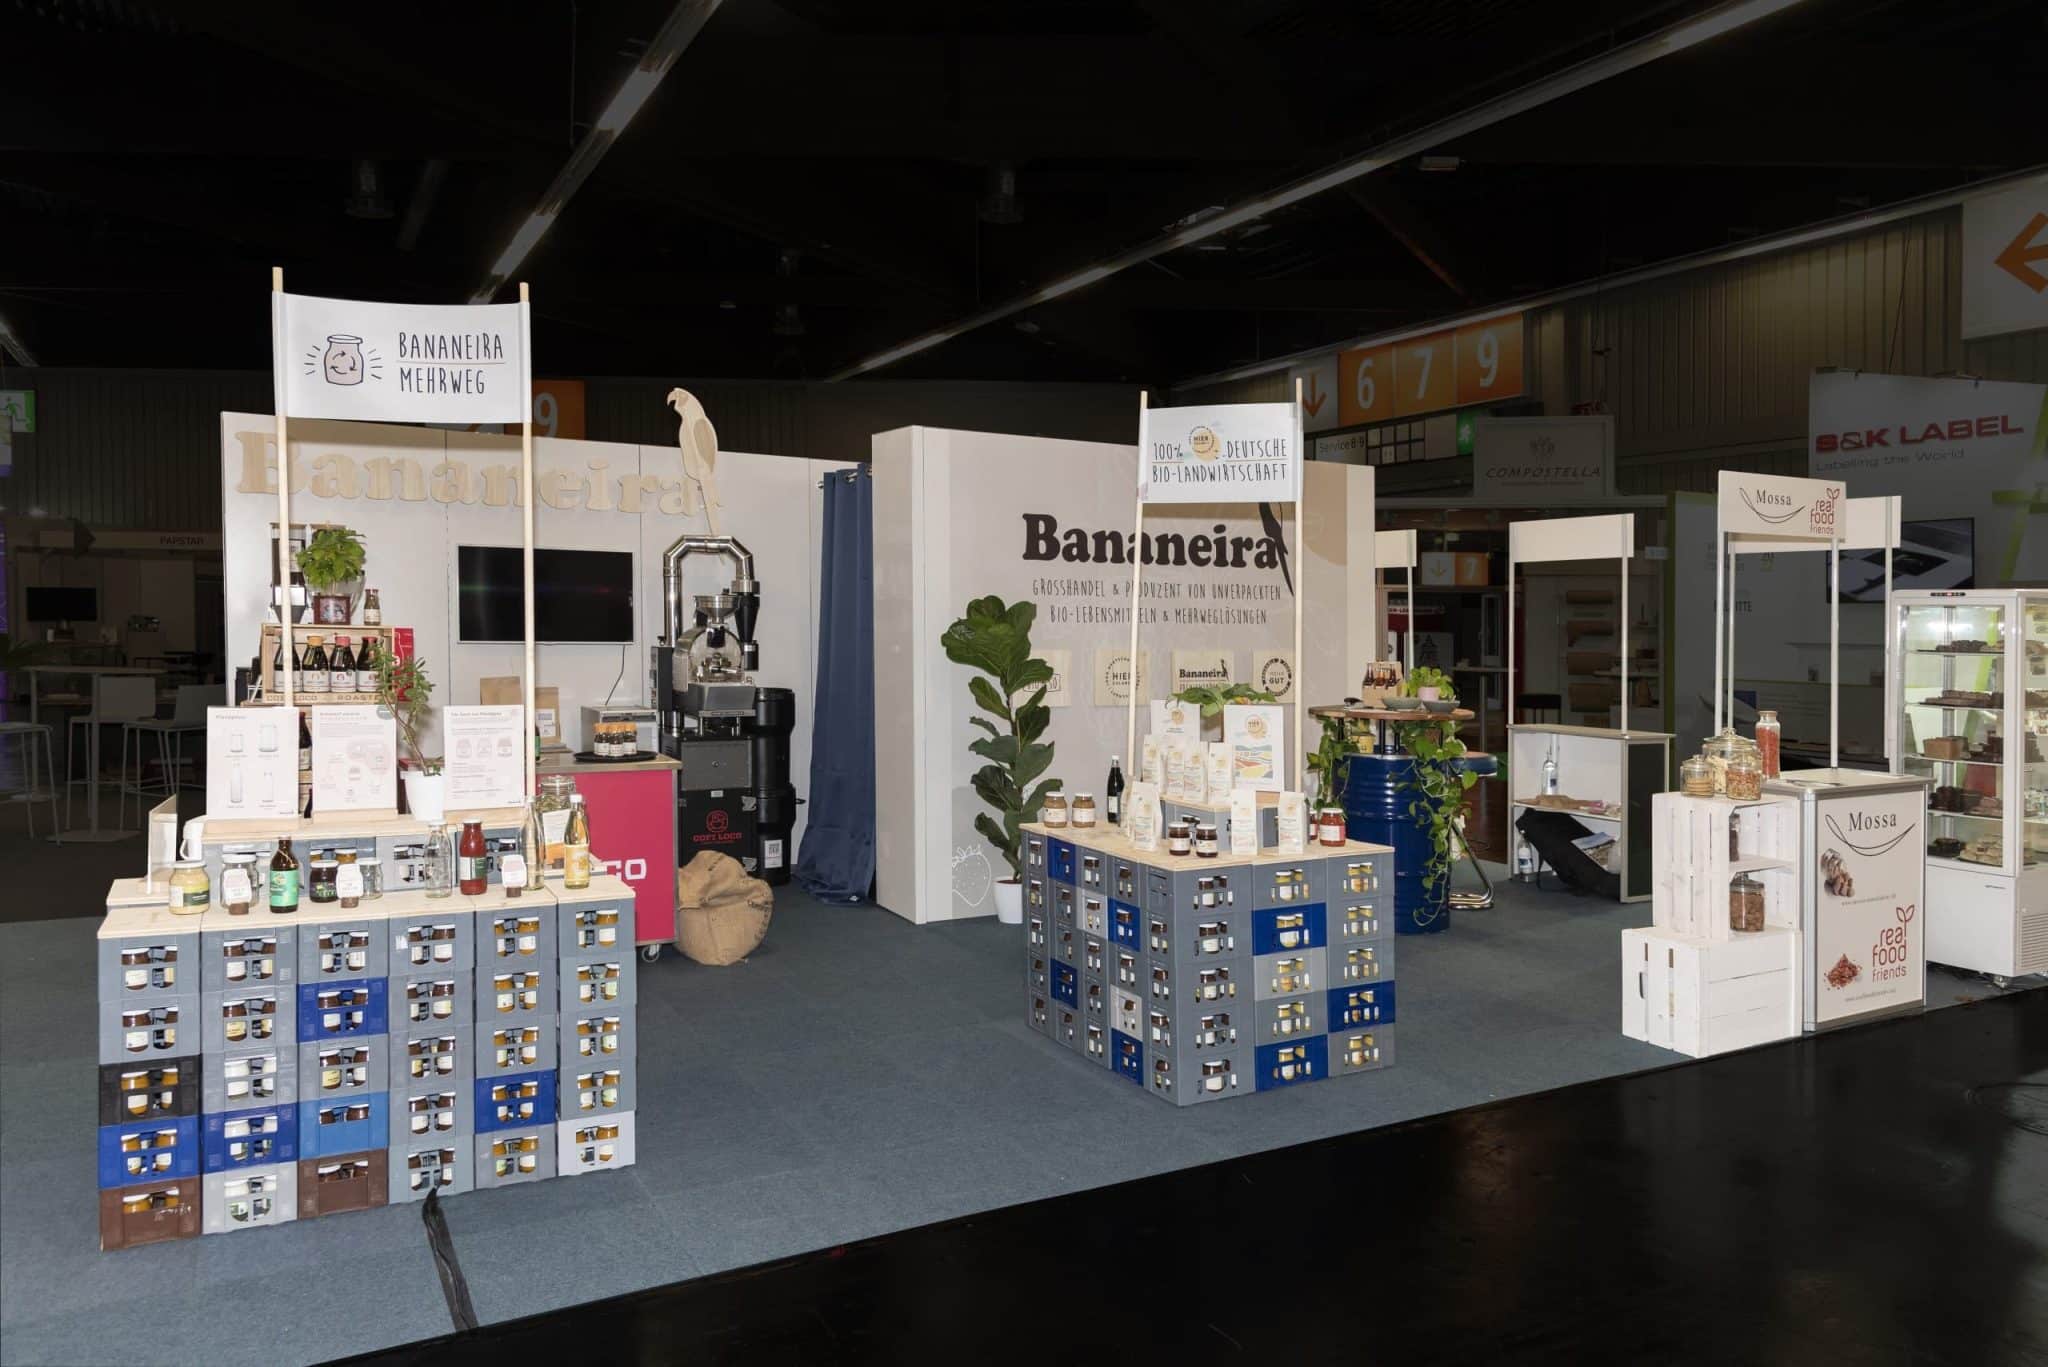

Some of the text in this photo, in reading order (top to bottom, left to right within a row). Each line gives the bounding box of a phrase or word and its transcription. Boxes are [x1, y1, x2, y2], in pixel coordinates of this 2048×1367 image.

[399, 332, 503, 360] BANANEIRA
[400, 367, 485, 394] MEHRWEG
[1356, 330, 1500, 409] 6 7 9
[534, 392, 558, 437] 9
[1815, 415, 2024, 453] S&K LABEL
[1153, 437, 1287, 460] 100% DEUTSCHE
[235, 431, 704, 516] Bananeira
[1153, 463, 1287, 483] BIO-LANDWIRTSCHAFT
[1486, 466, 1601, 479] COMPOSTELLA
[1756, 488, 1835, 513] Mossa real
[1810, 508, 1835, 525] food
[1022, 512, 1280, 569] Bananeira
[1032, 578, 1106, 598] GROSSHANDEL
[1187, 583, 1206, 598] VON
[1212, 583, 1281, 601] UNVERPACKTEN
[1050, 605, 1157, 624] BIO-LEBENSMITELN
[1848, 811, 1897, 832] Mossa
[1880, 920, 1907, 947] real
[1872, 940, 1907, 968] food
[1872, 965, 1907, 984] friends
